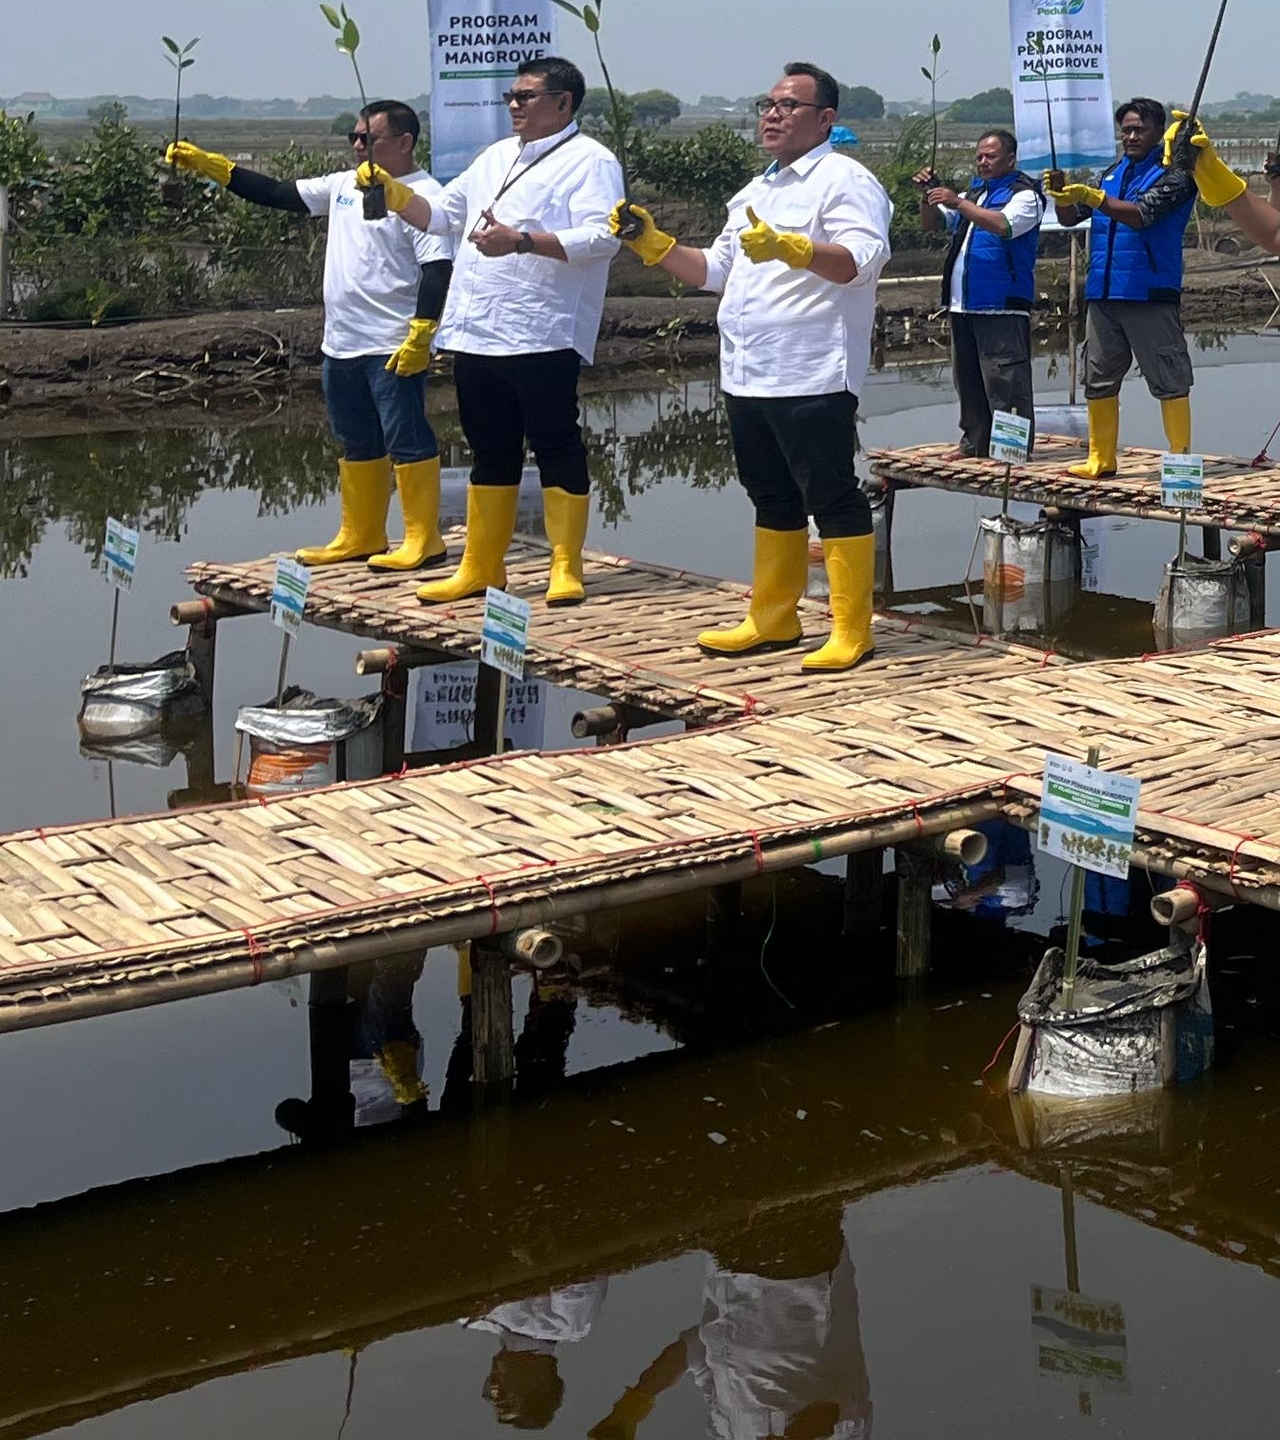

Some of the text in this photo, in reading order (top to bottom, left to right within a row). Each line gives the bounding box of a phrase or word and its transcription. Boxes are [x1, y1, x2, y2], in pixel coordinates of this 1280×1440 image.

[450, 14, 538, 29] PROGRAM
[438, 31, 551, 47] PENANAMAN
[445, 49, 545, 65] MANGROVE
[1023, 58, 1099, 70] MANGROVE
